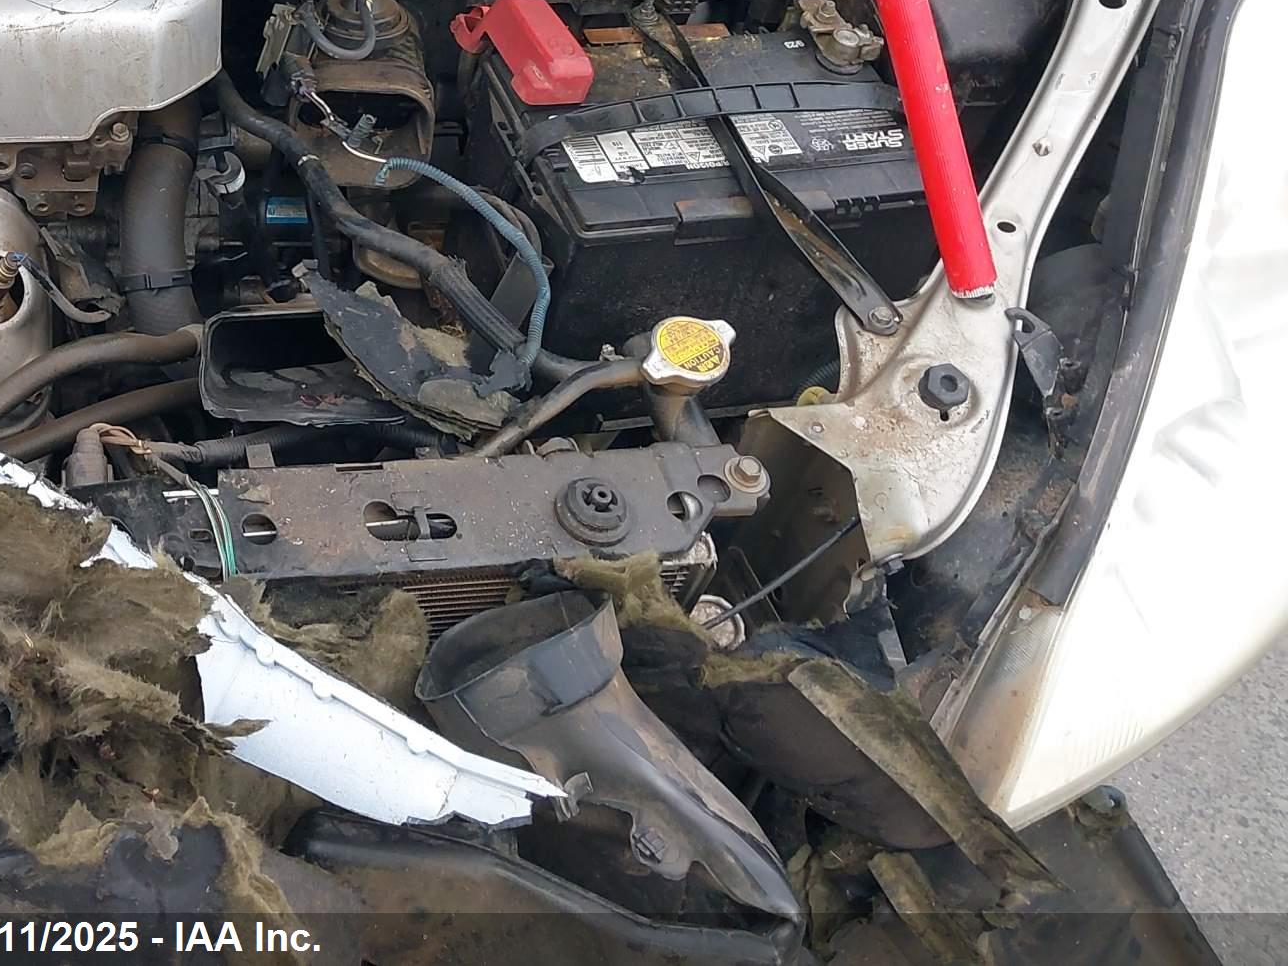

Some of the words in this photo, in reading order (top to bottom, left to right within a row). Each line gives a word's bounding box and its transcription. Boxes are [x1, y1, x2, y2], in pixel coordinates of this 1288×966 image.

[842, 129, 905, 143] START
[844, 139, 903, 151] SUPER
[682, 346, 721, 370] CAUTION
